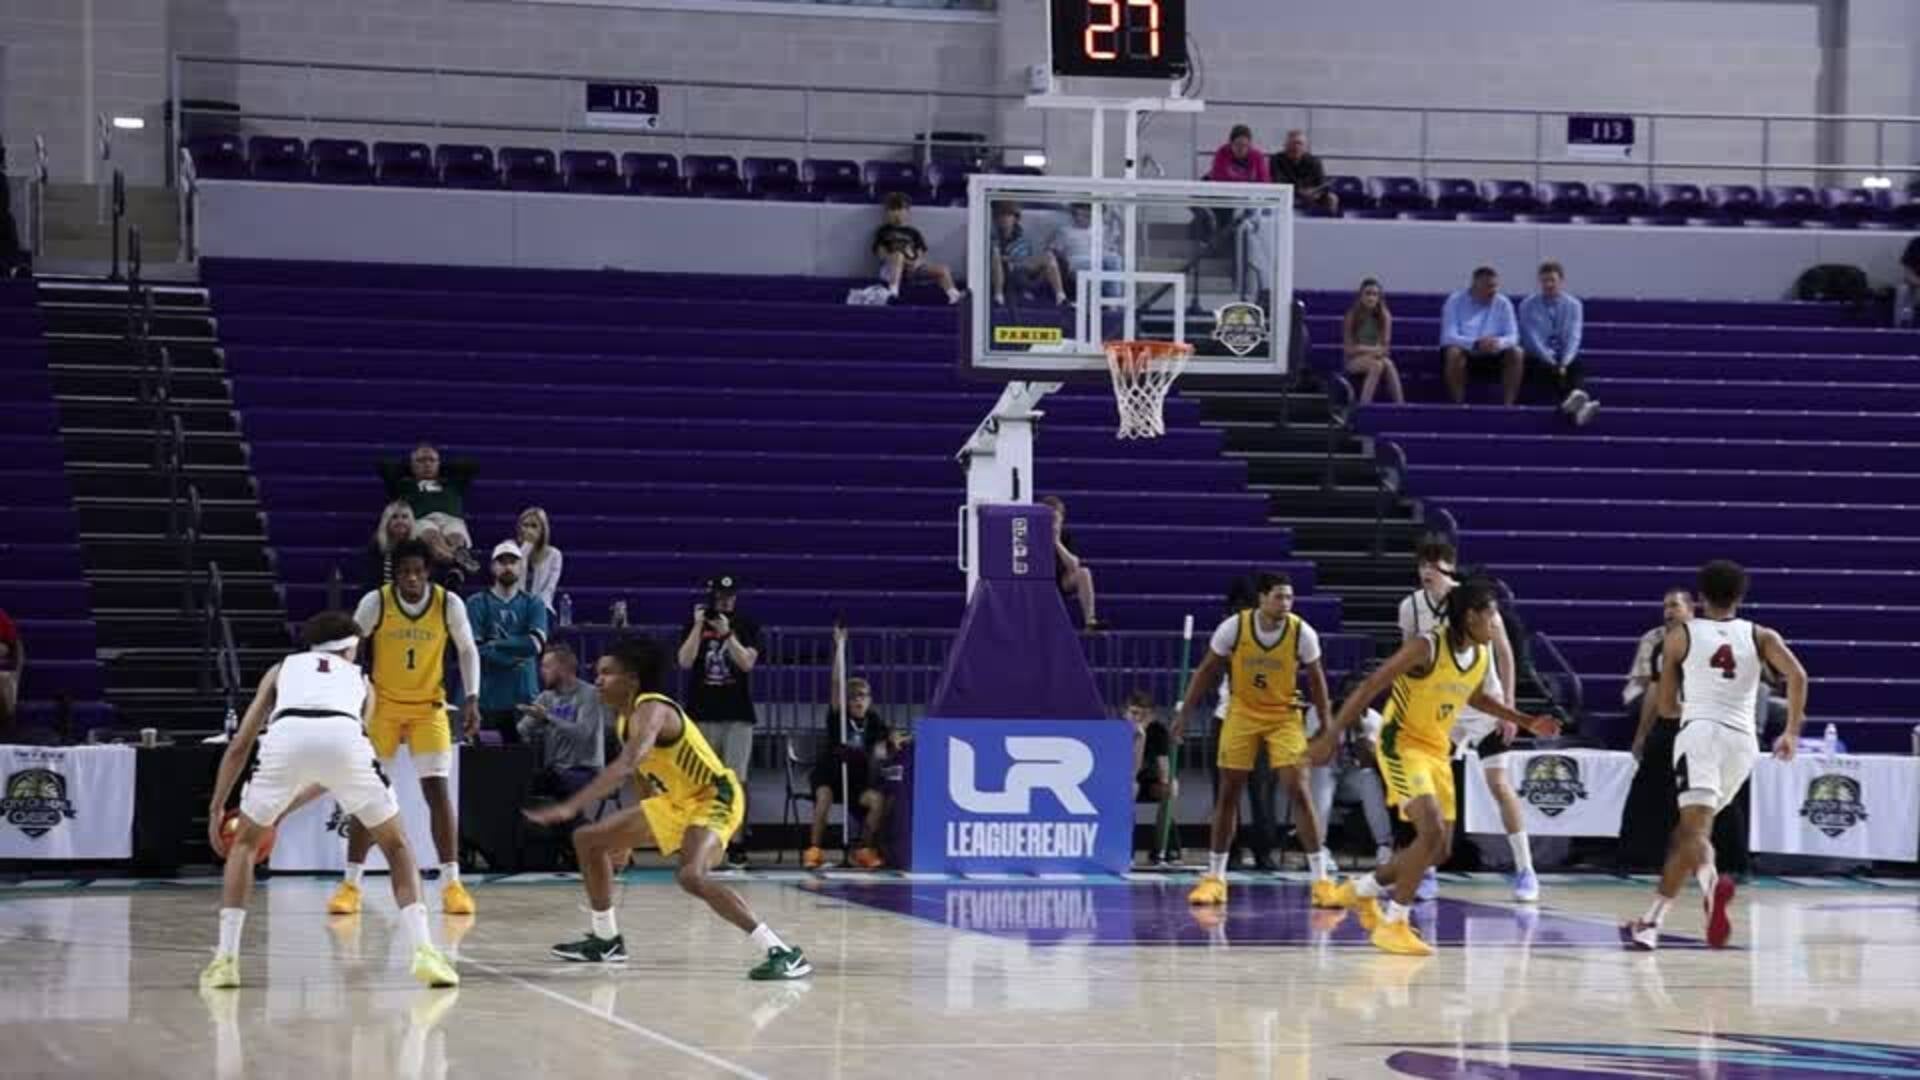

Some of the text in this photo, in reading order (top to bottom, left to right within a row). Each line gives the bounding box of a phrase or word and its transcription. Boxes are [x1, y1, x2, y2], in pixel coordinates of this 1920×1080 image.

[1085, 0, 1159, 59] 27
[613, 88, 647, 108] 112
[1592, 122, 1623, 140] 113
[316, 657, 331, 673] 1
[406, 648, 416, 670] 1
[1709, 643, 1737, 679] 4
[1252, 672, 1268, 689] 5
[947, 821, 1099, 858] LEAGUEREADY
